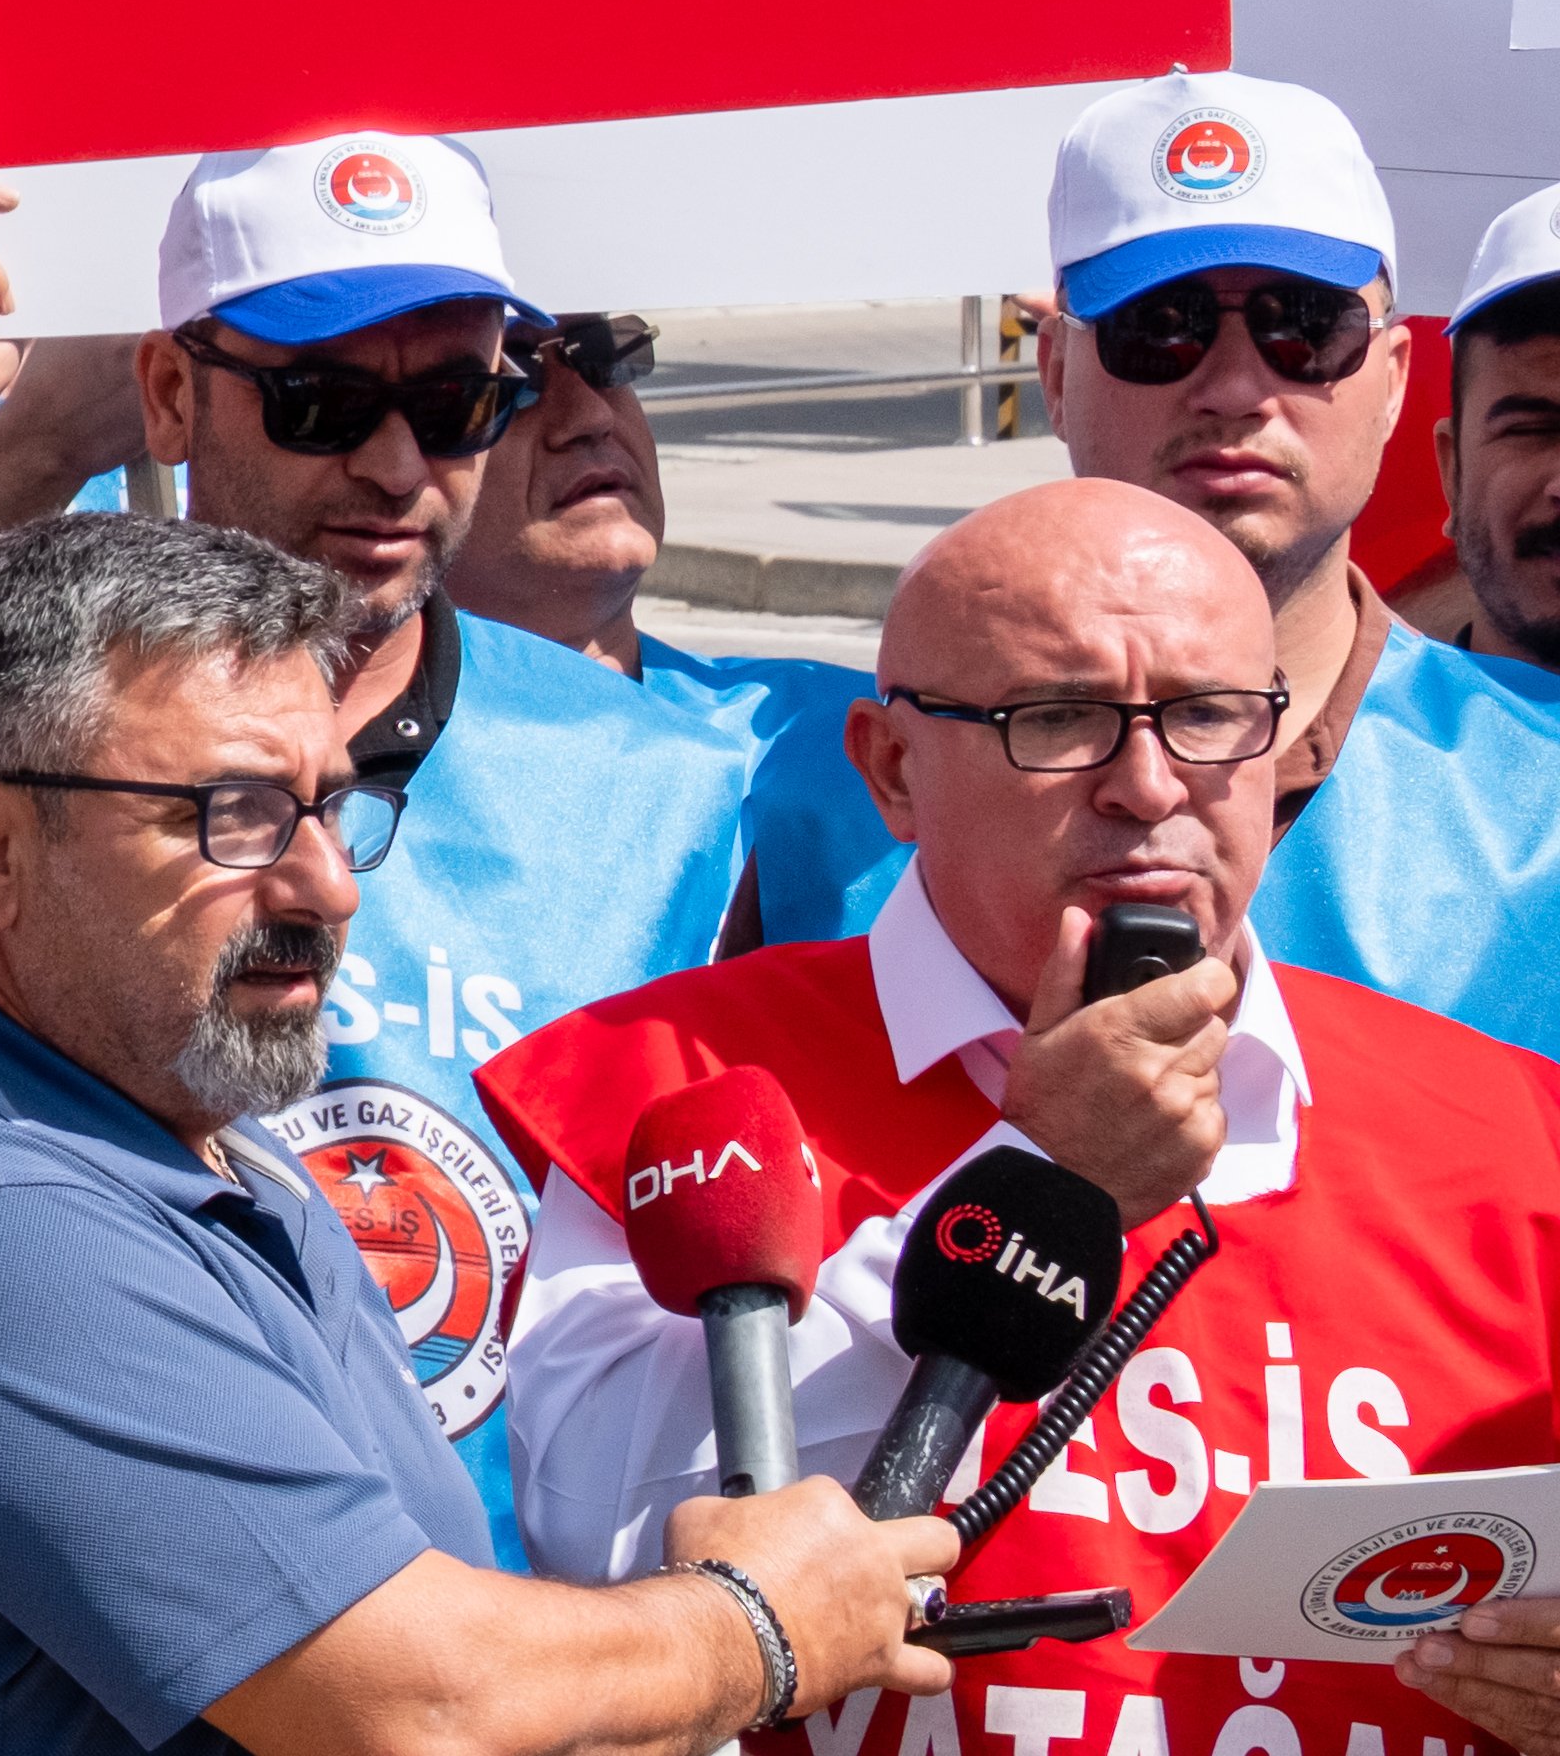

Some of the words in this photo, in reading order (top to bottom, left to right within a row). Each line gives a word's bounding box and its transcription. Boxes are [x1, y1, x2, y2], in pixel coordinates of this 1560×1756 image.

[322, 946, 523, 1066] S-İŞ
[311, 1102, 348, 1132] VE
[357, 1099, 410, 1132] GAZ
[418, 1114, 512, 1218] İŞÇİLERİ
[627, 1139, 762, 1210] DHA
[996, 1232, 1088, 1323] İHA
[1426, 1519, 1447, 1532] VE
[1452, 1517, 1486, 1530] GAZ
[1326, 1621, 1389, 1639] ANKARA
